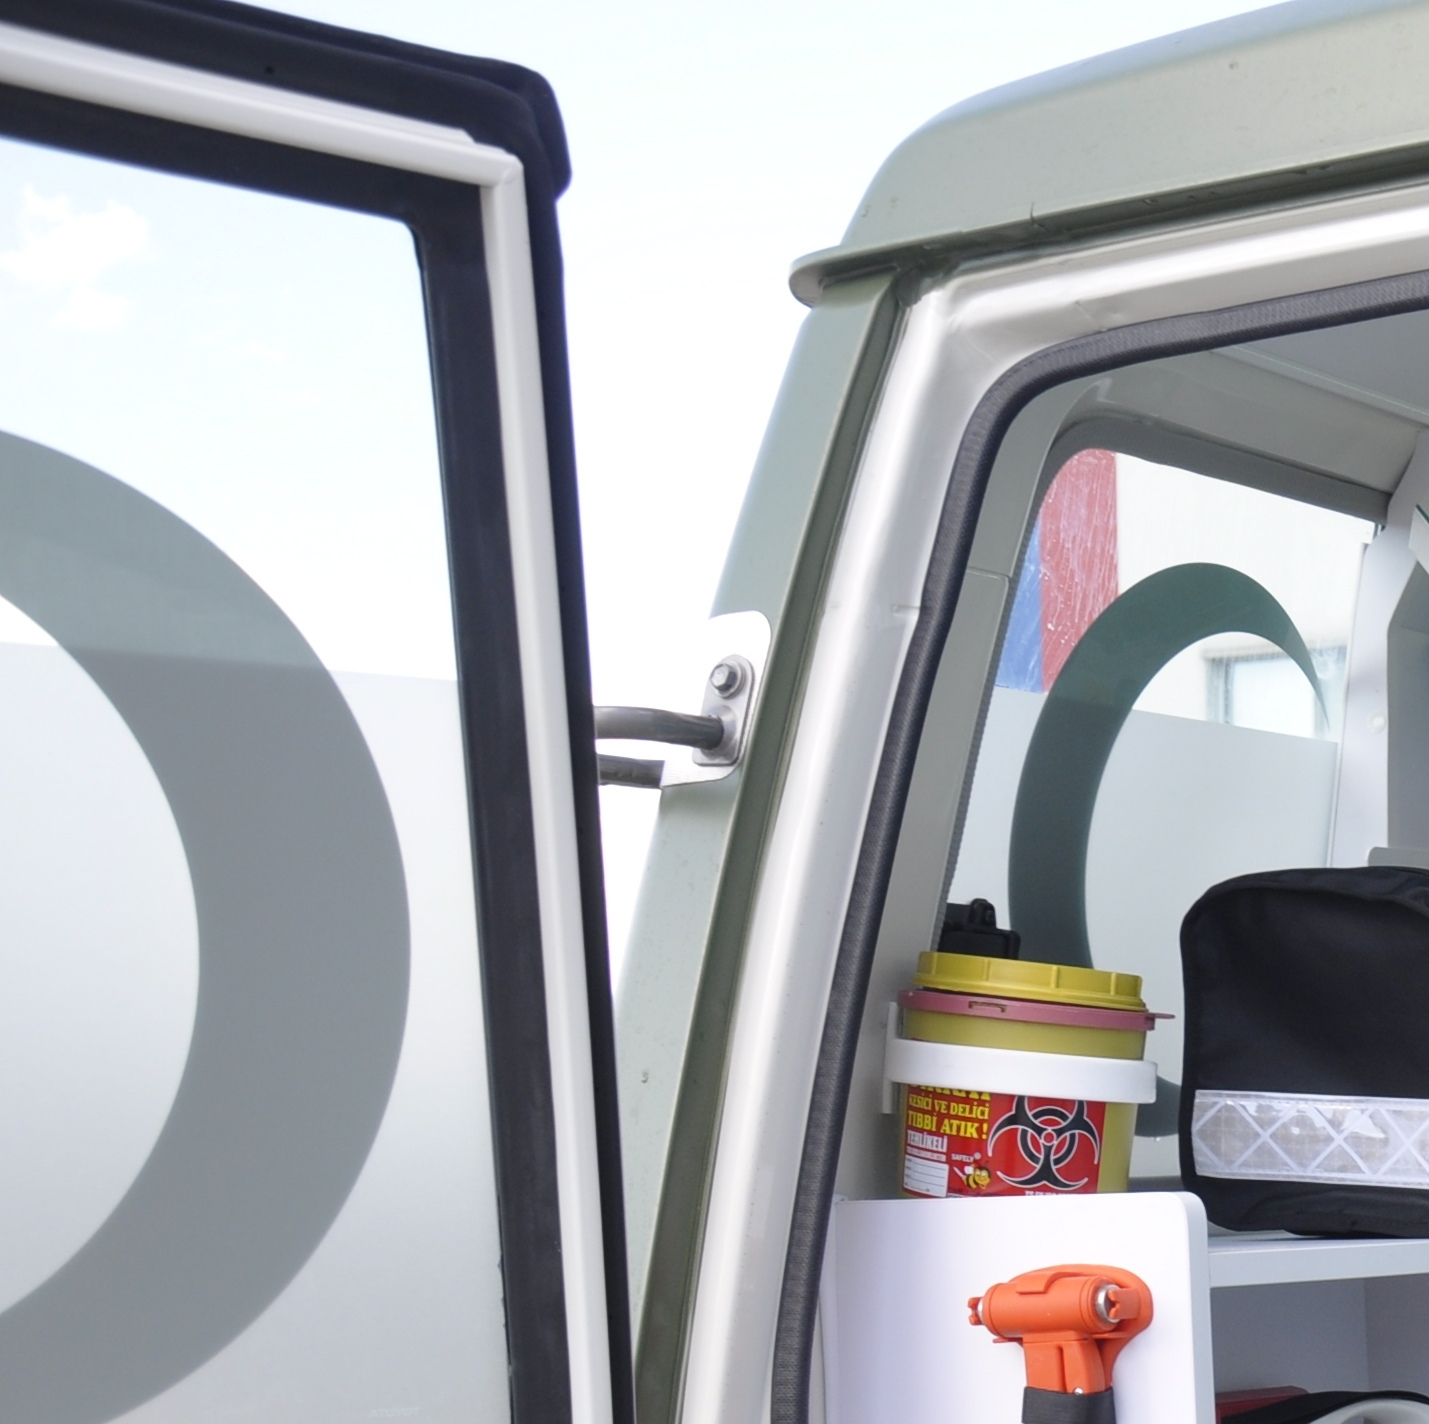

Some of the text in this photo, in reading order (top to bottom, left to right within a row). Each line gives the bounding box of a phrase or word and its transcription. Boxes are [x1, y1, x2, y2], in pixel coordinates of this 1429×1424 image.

[934, 1099, 948, 1113] VE
[950, 1101, 990, 1119] DELİCİ
[908, 1110, 937, 1131] TIBBİ
[940, 1118, 980, 1139] ATIK
